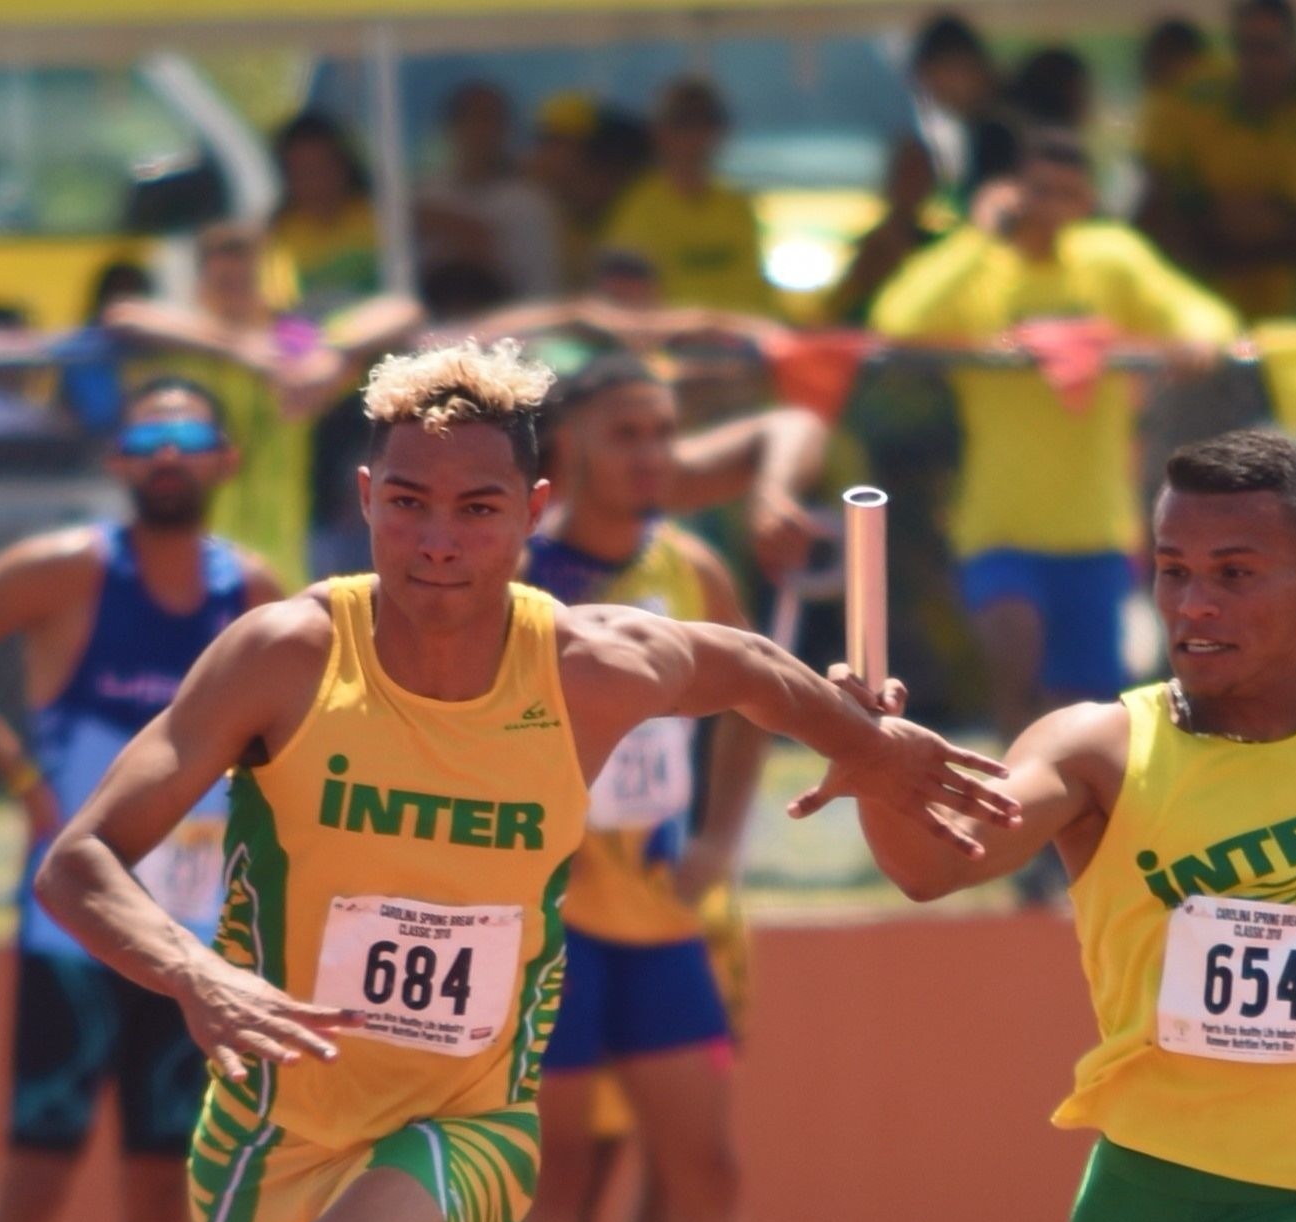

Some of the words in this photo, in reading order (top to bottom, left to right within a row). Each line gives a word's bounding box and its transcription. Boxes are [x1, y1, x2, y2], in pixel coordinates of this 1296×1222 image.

[380, 903, 417, 922] CAROLINA
[419, 912, 448, 926] SPRING
[1216, 908, 1251, 922] CAROLINA
[1253, 911, 1279, 926] SPRING
[398, 923, 431, 939] CLASSIC
[1234, 924, 1264, 939] CLASSIC
[363, 940, 473, 1015] 684
